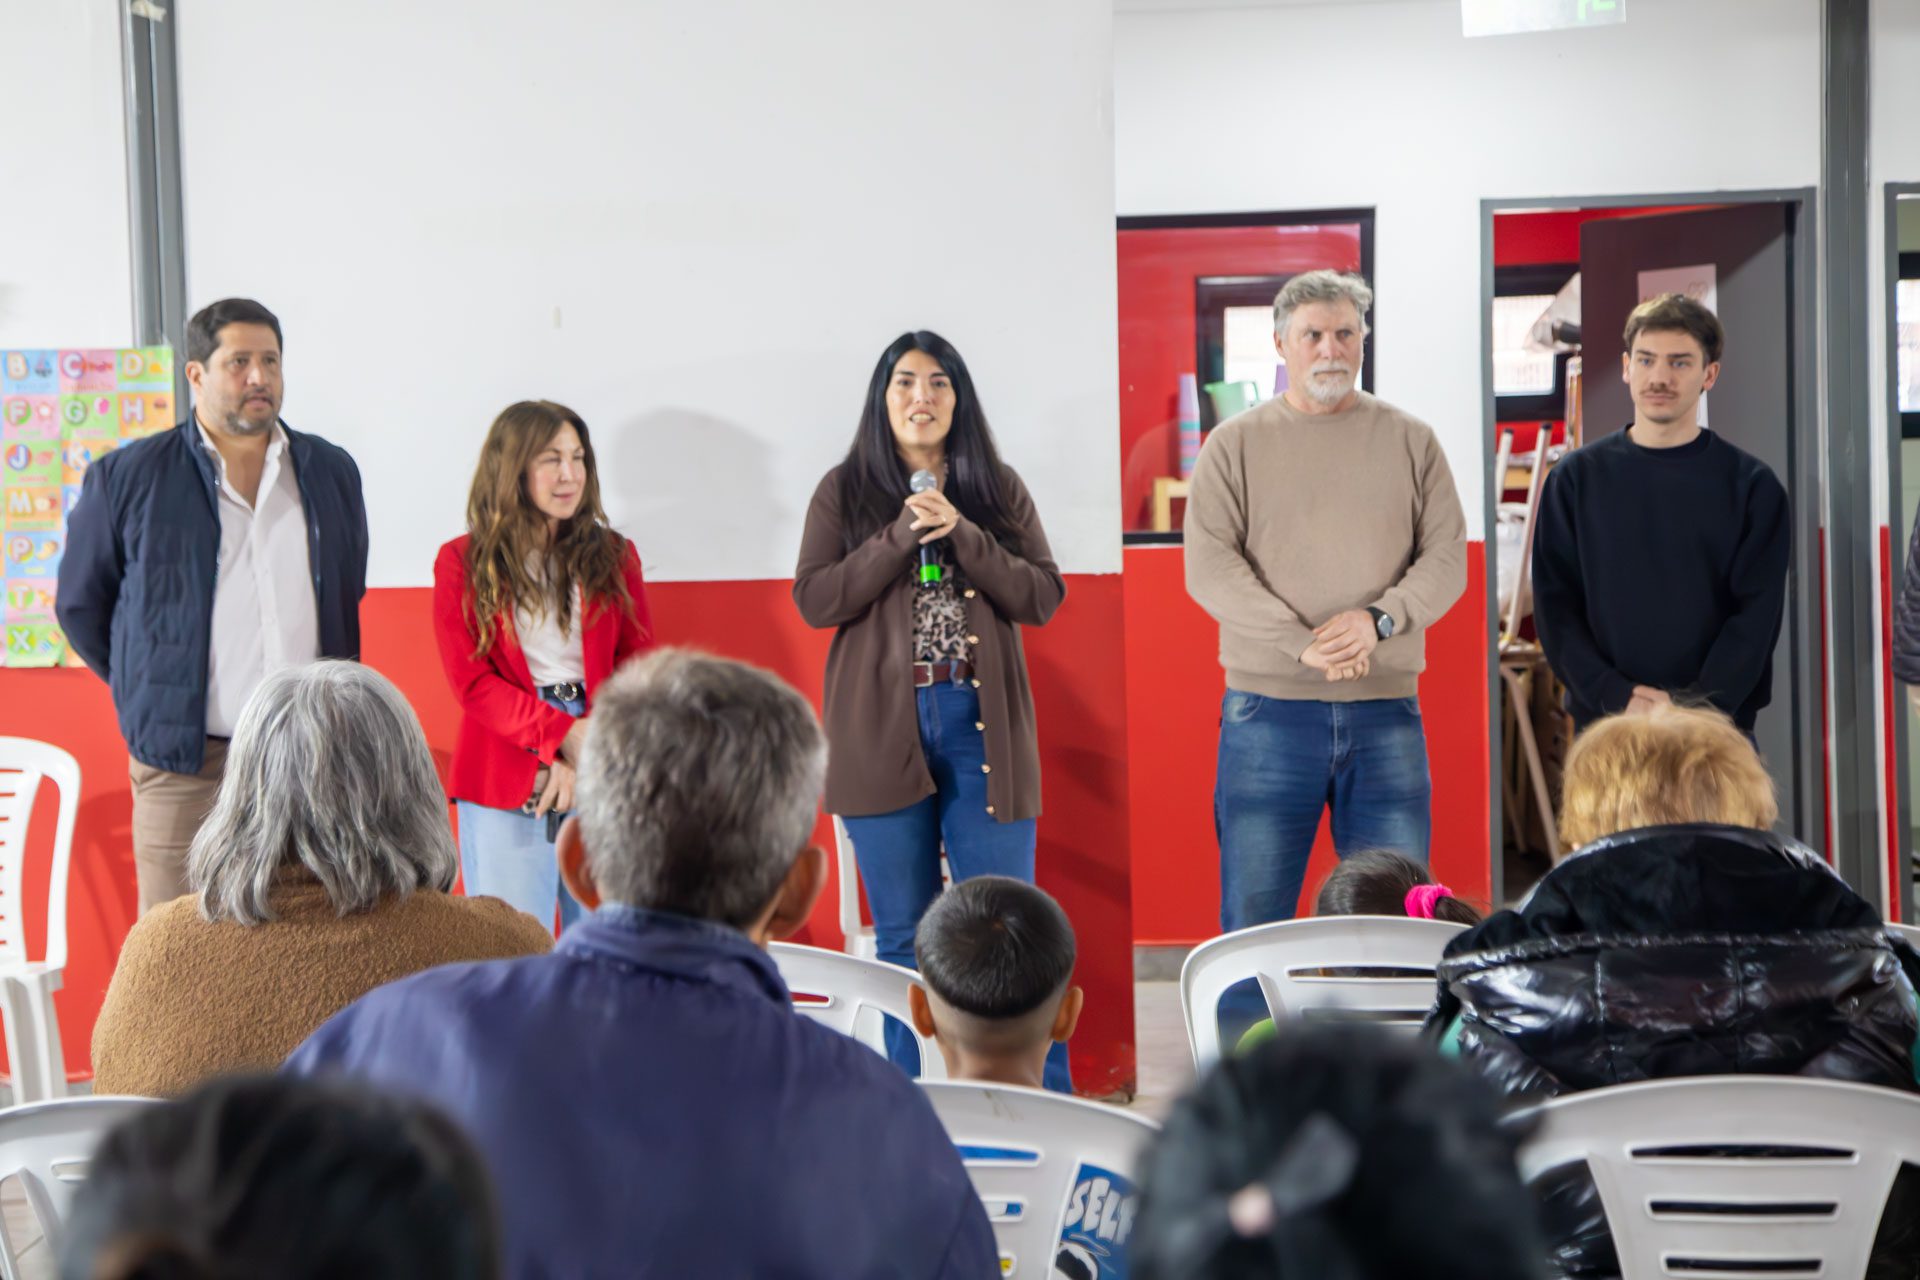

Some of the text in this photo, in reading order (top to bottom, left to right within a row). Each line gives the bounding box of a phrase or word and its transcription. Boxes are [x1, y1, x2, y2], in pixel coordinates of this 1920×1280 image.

[8, 352, 27, 379] B
[63, 353, 83, 379] C
[123, 352, 142, 377] D
[10, 400, 26, 423] F
[65, 400, 85, 422] G
[122, 397, 143, 423] H
[9, 444, 27, 469] J
[67, 443, 87, 468] K
[9, 491, 32, 513] M
[13, 537, 30, 563] P
[14, 585, 29, 609] T
[12, 630, 30, 652] X
